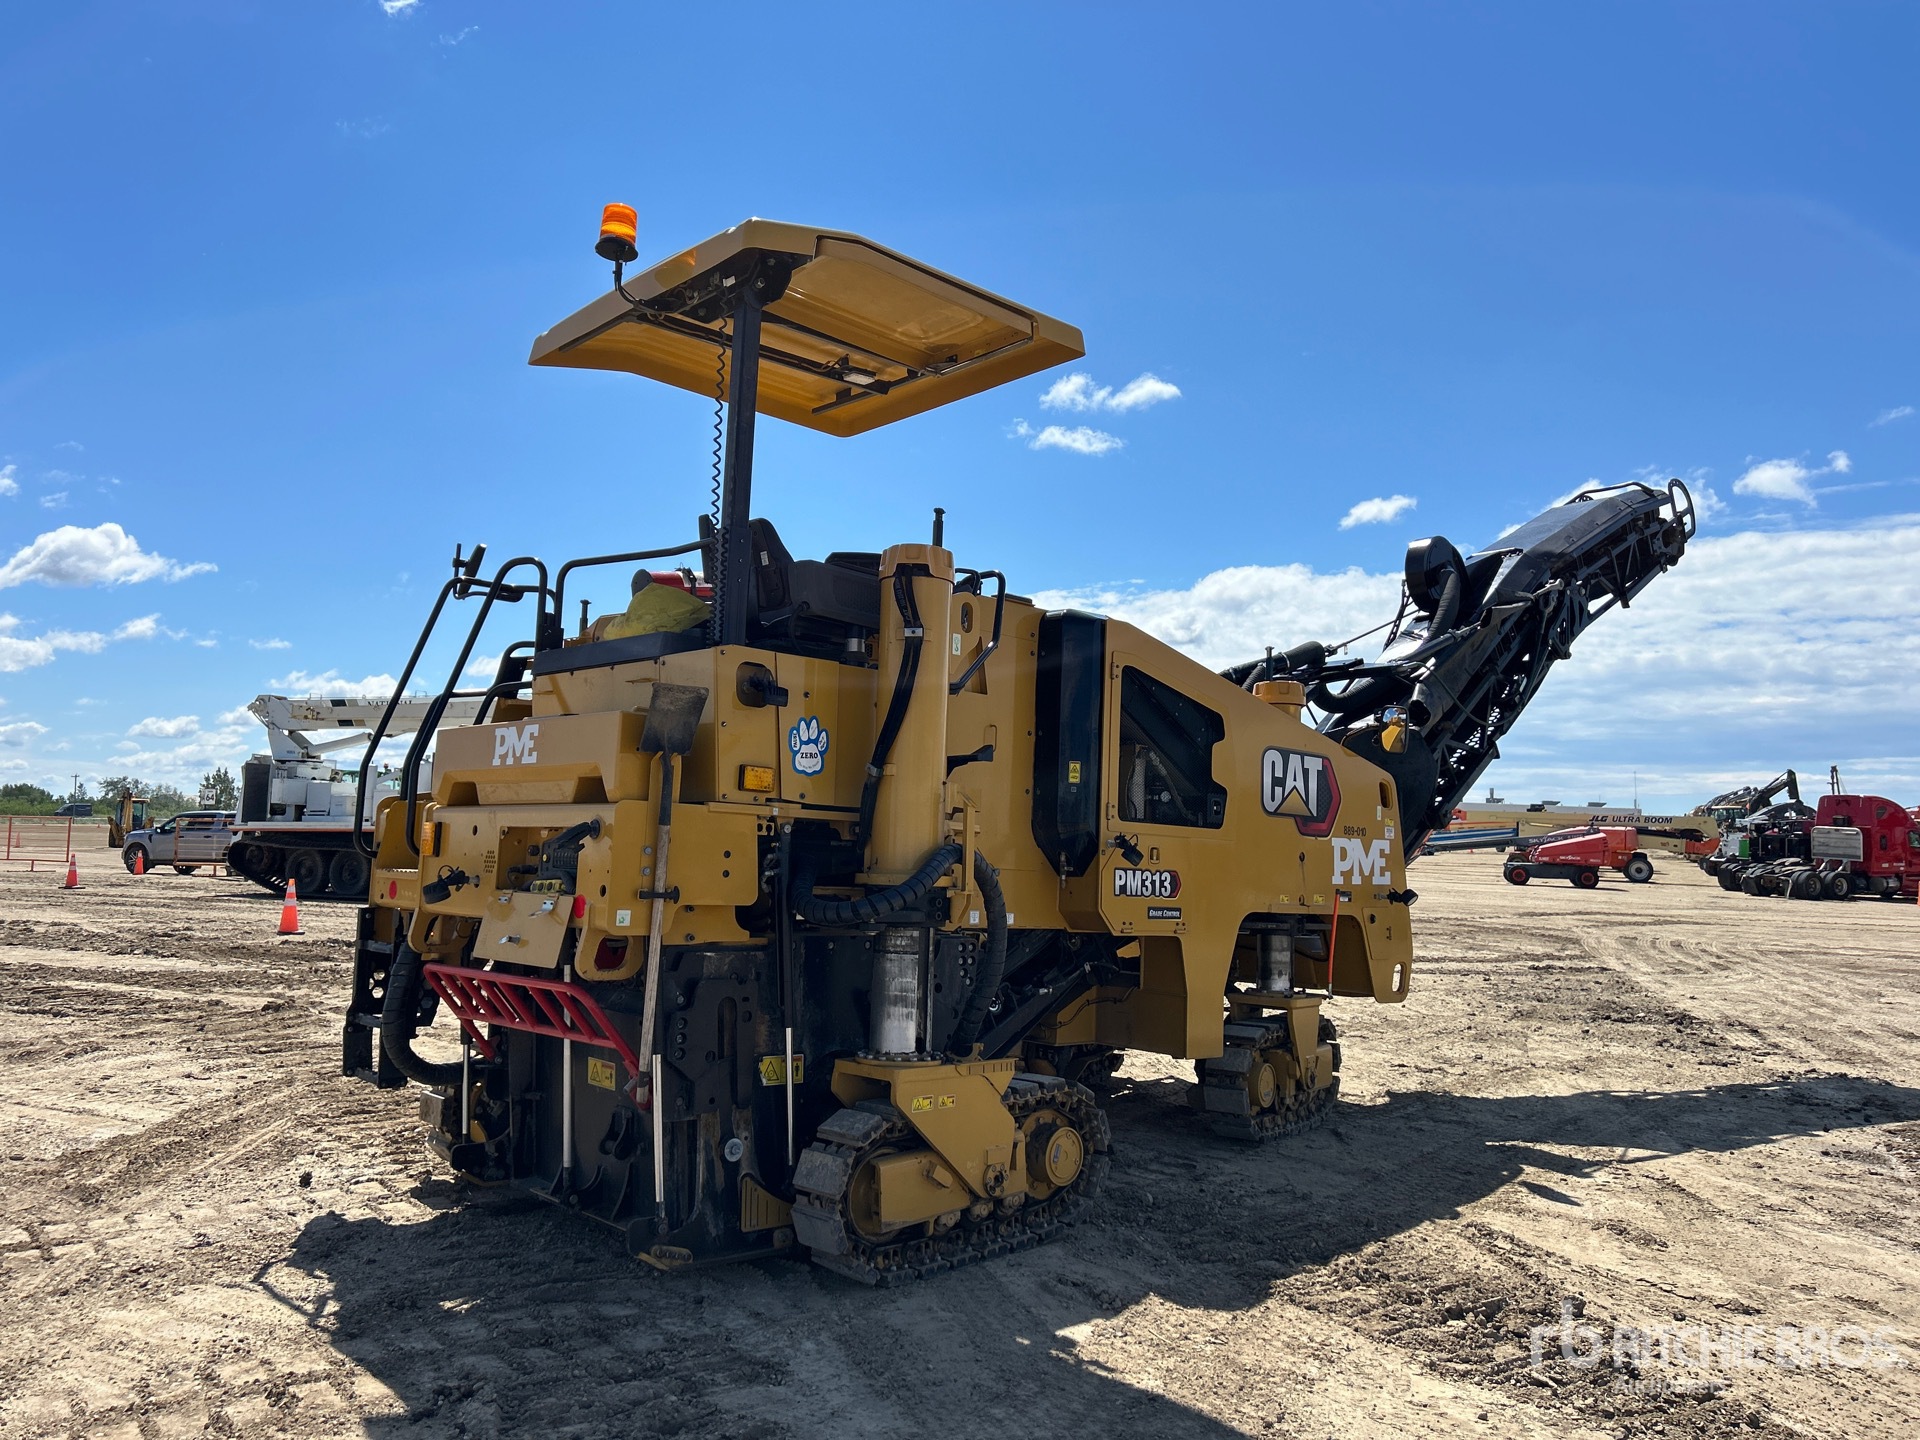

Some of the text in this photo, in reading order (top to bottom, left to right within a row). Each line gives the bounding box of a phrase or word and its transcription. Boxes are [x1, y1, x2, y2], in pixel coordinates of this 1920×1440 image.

[492, 724, 539, 766] PME
[1262, 749, 1323, 817] CAT
[205, 793, 215, 802] 64
[1589, 815, 1673, 824] JLG ULTRA BOOM
[1343, 825, 1367, 837] 889-010
[1528, 835, 1564, 844] SKYJACK
[1331, 837, 1391, 885] PME
[1114, 869, 1172, 897] PM313
[1149, 909, 1163, 917] GRADE
